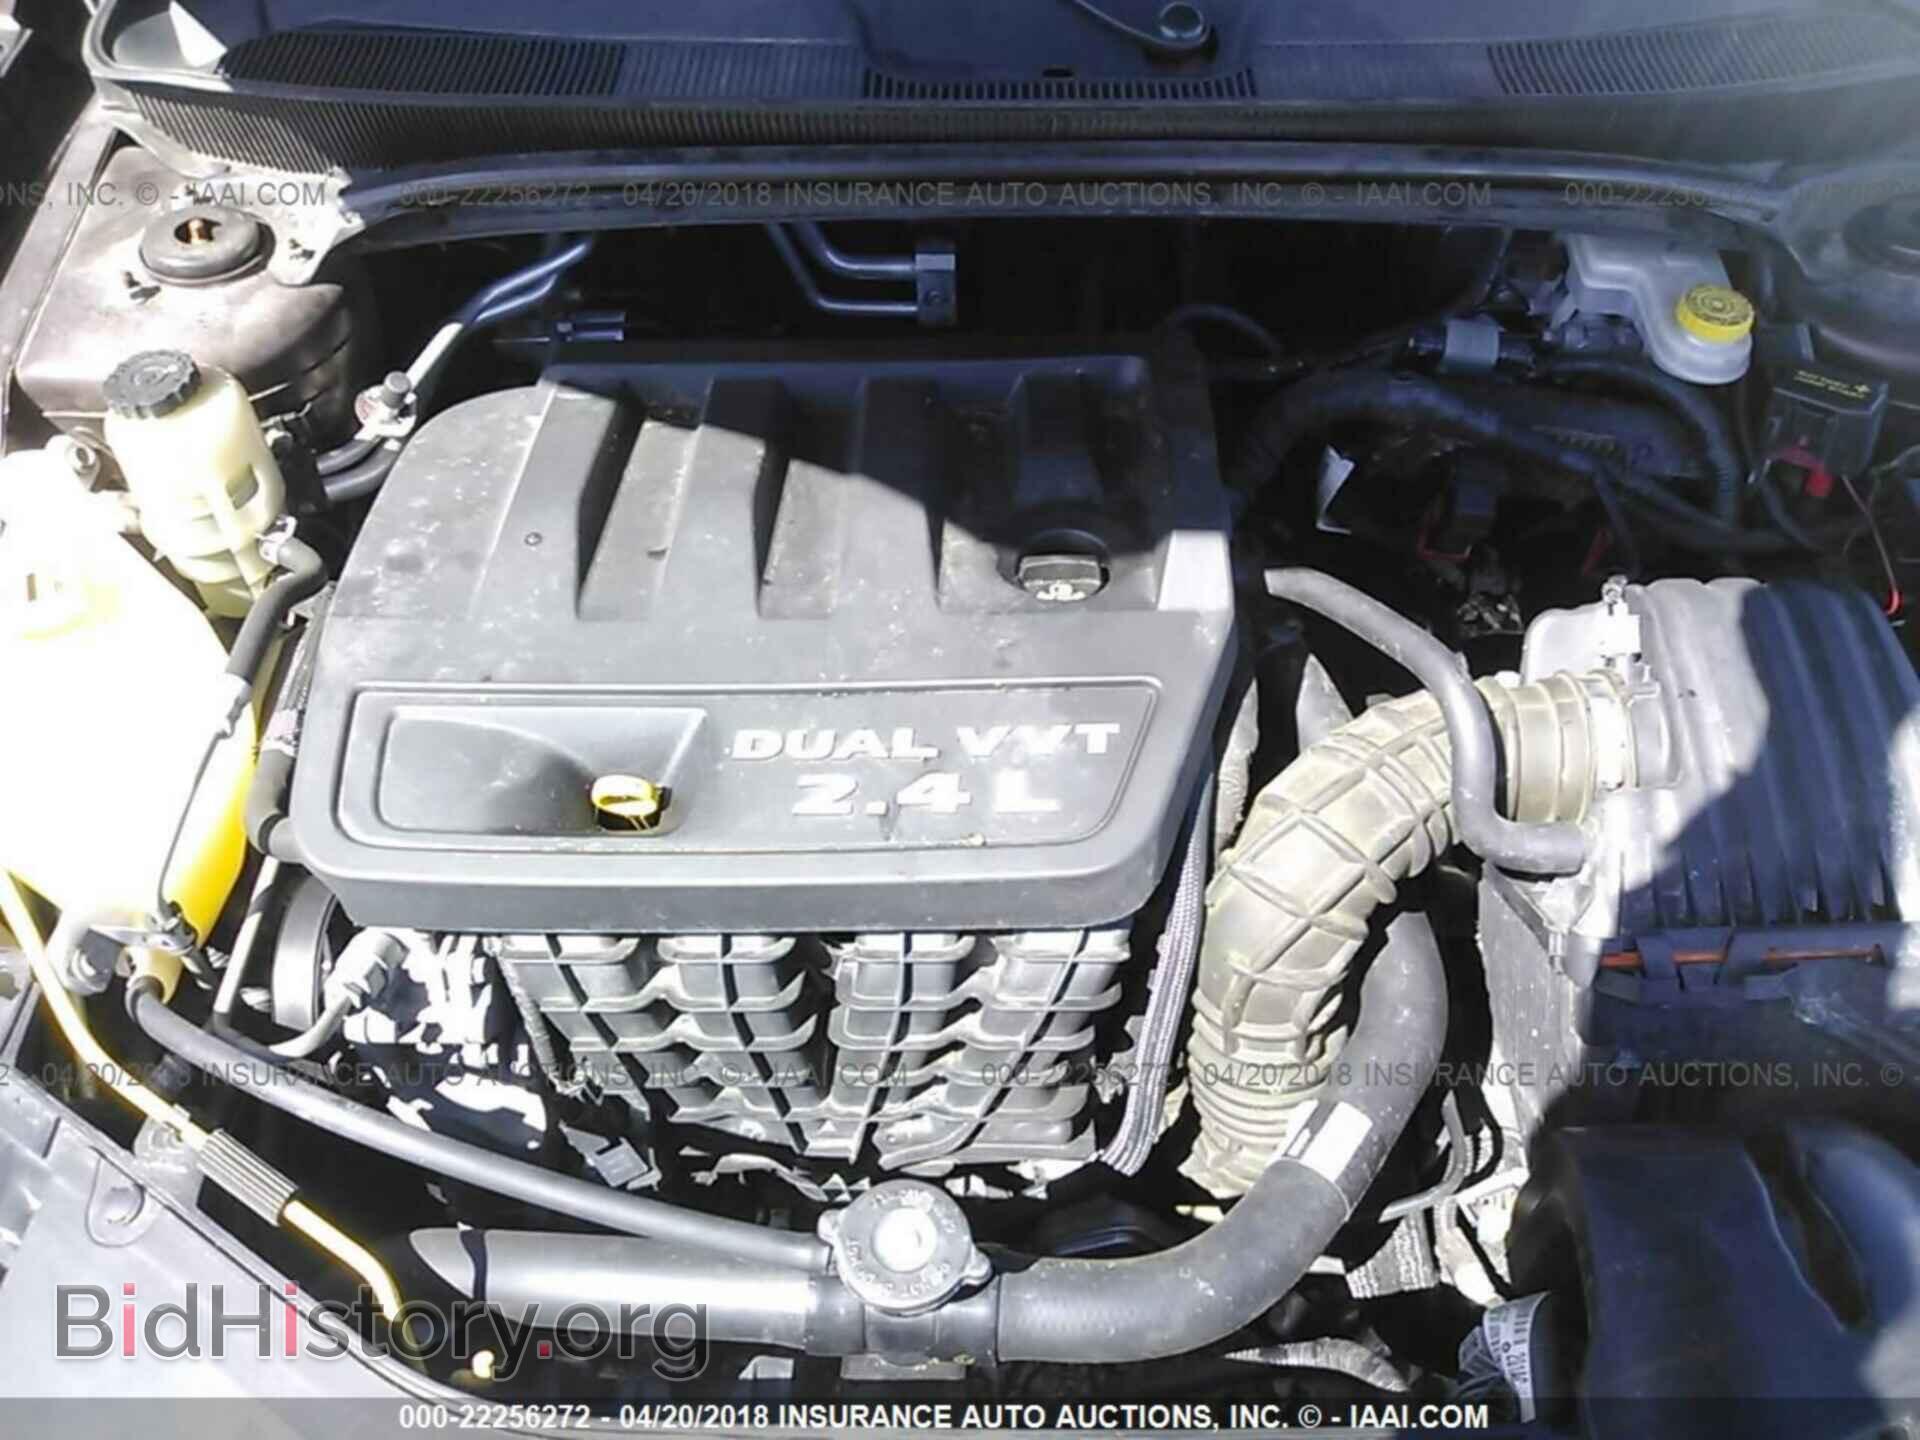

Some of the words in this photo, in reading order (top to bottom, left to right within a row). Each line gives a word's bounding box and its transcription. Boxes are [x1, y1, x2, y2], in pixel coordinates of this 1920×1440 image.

[731, 728, 939, 762] DUAL
[956, 723, 1120, 757] VVT
[992, 769, 1060, 813] L
